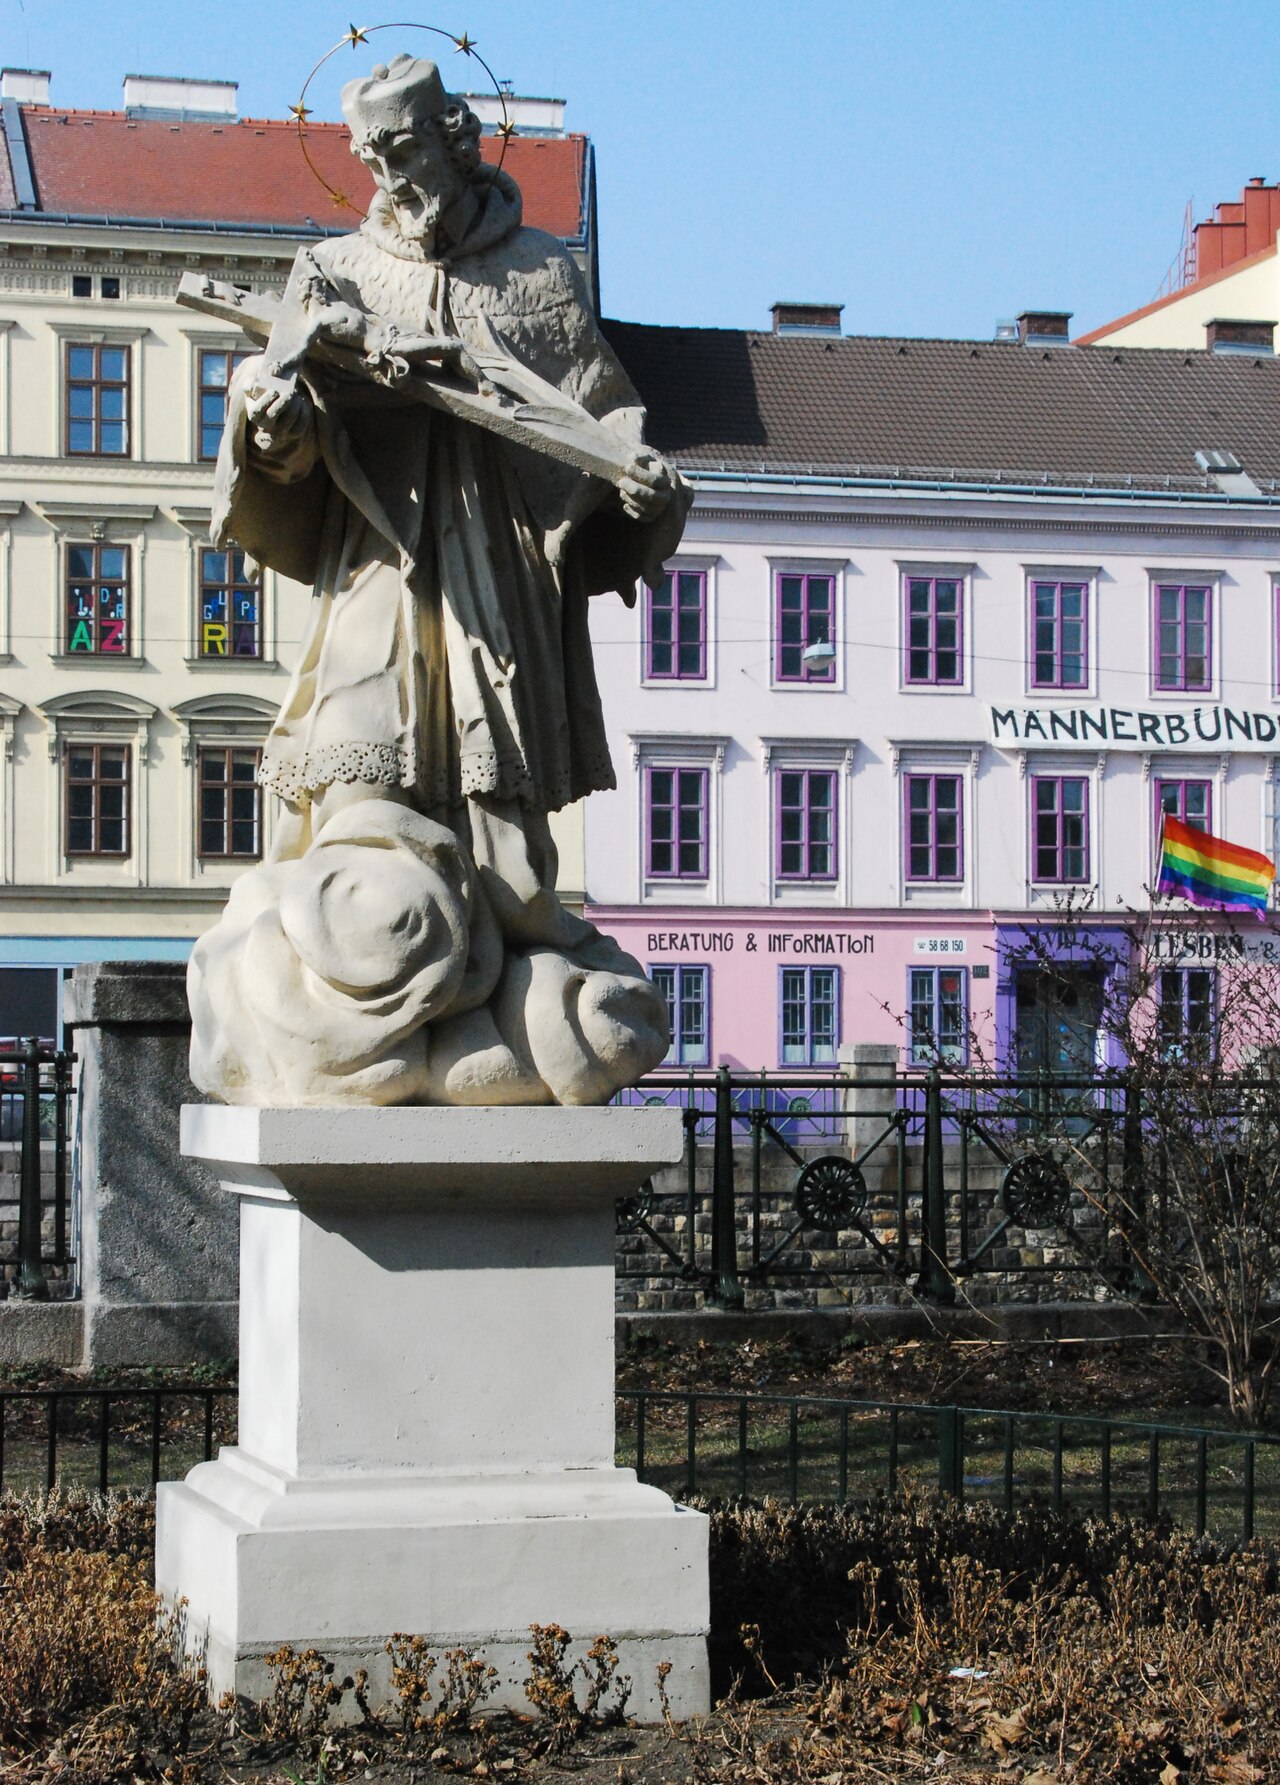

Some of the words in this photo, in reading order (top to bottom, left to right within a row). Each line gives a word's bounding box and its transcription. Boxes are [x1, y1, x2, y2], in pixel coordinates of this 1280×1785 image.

[991, 706, 1280, 744] MÄNNERBÜND
[648, 933, 734, 952] BERATUNG
[746, 933, 758, 952] &
[929, 940, 938, 951] 58
[940, 940, 949, 951] 68
[952, 940, 964, 951] 150
